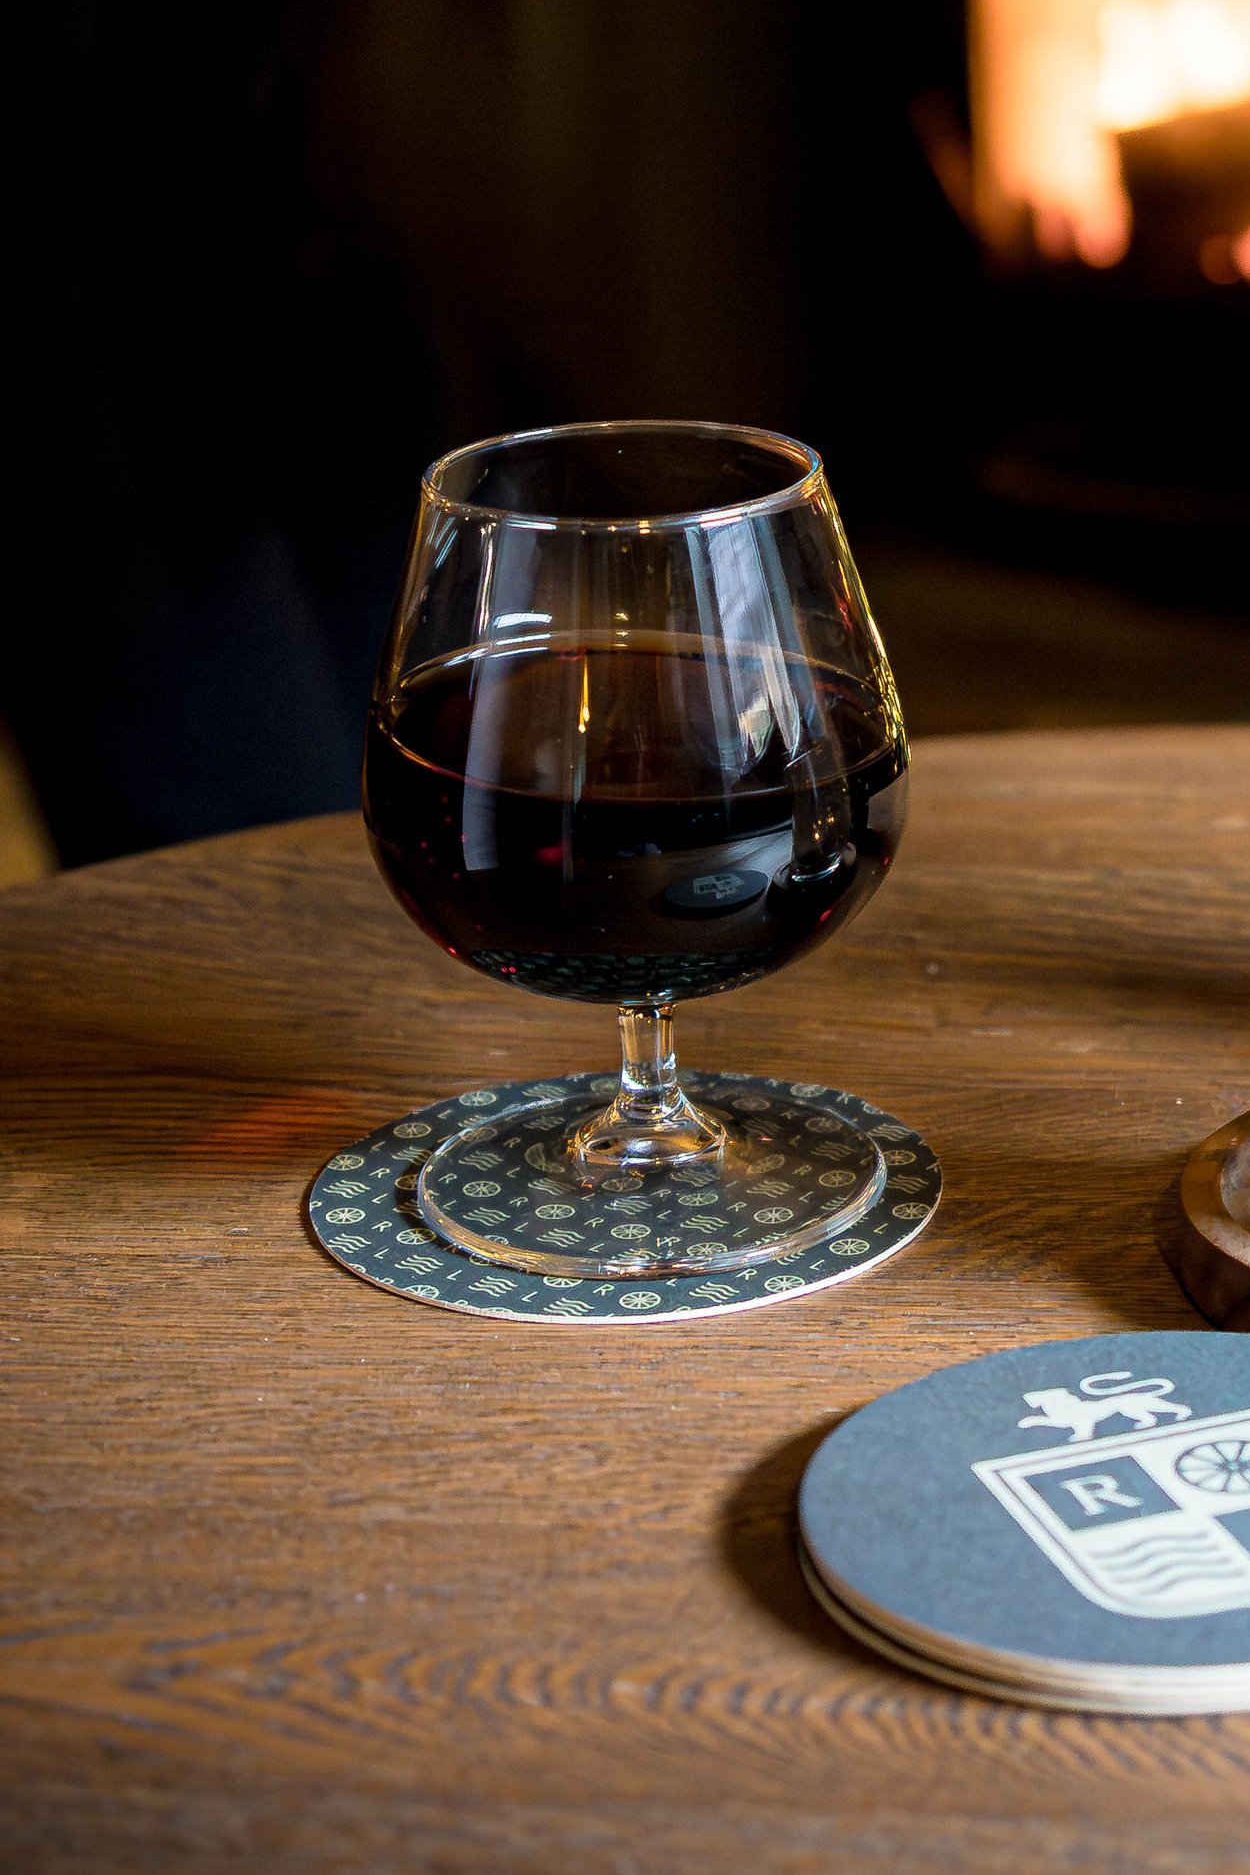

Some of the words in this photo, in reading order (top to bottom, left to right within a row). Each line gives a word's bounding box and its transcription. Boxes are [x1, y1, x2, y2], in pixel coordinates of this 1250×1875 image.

[369, 1167, 391, 1179] R
[506, 1166, 521, 1178] L
[438, 1173, 458, 1184] R
[371, 1193, 389, 1205] L
[509, 1196, 528, 1208] R
[798, 1191, 814, 1203] L
[443, 1200, 457, 1211] L
[726, 1201, 748, 1212] R
[656, 1209, 672, 1220] L
[371, 1221, 393, 1233] R
[513, 1222, 529, 1233] L
[584, 1217, 604, 1229] R
[873, 1223, 888, 1235] L
[660, 1235, 681, 1247] R
[373, 1248, 390, 1260] L
[588, 1243, 605, 1253] L
[809, 1259, 825, 1271] L
[446, 1269, 463, 1281] L
[735, 1268, 757, 1281] R
[592, 1283, 615, 1296] R
[521, 1290, 539, 1303] L
[1059, 1473, 1143, 1517] R
